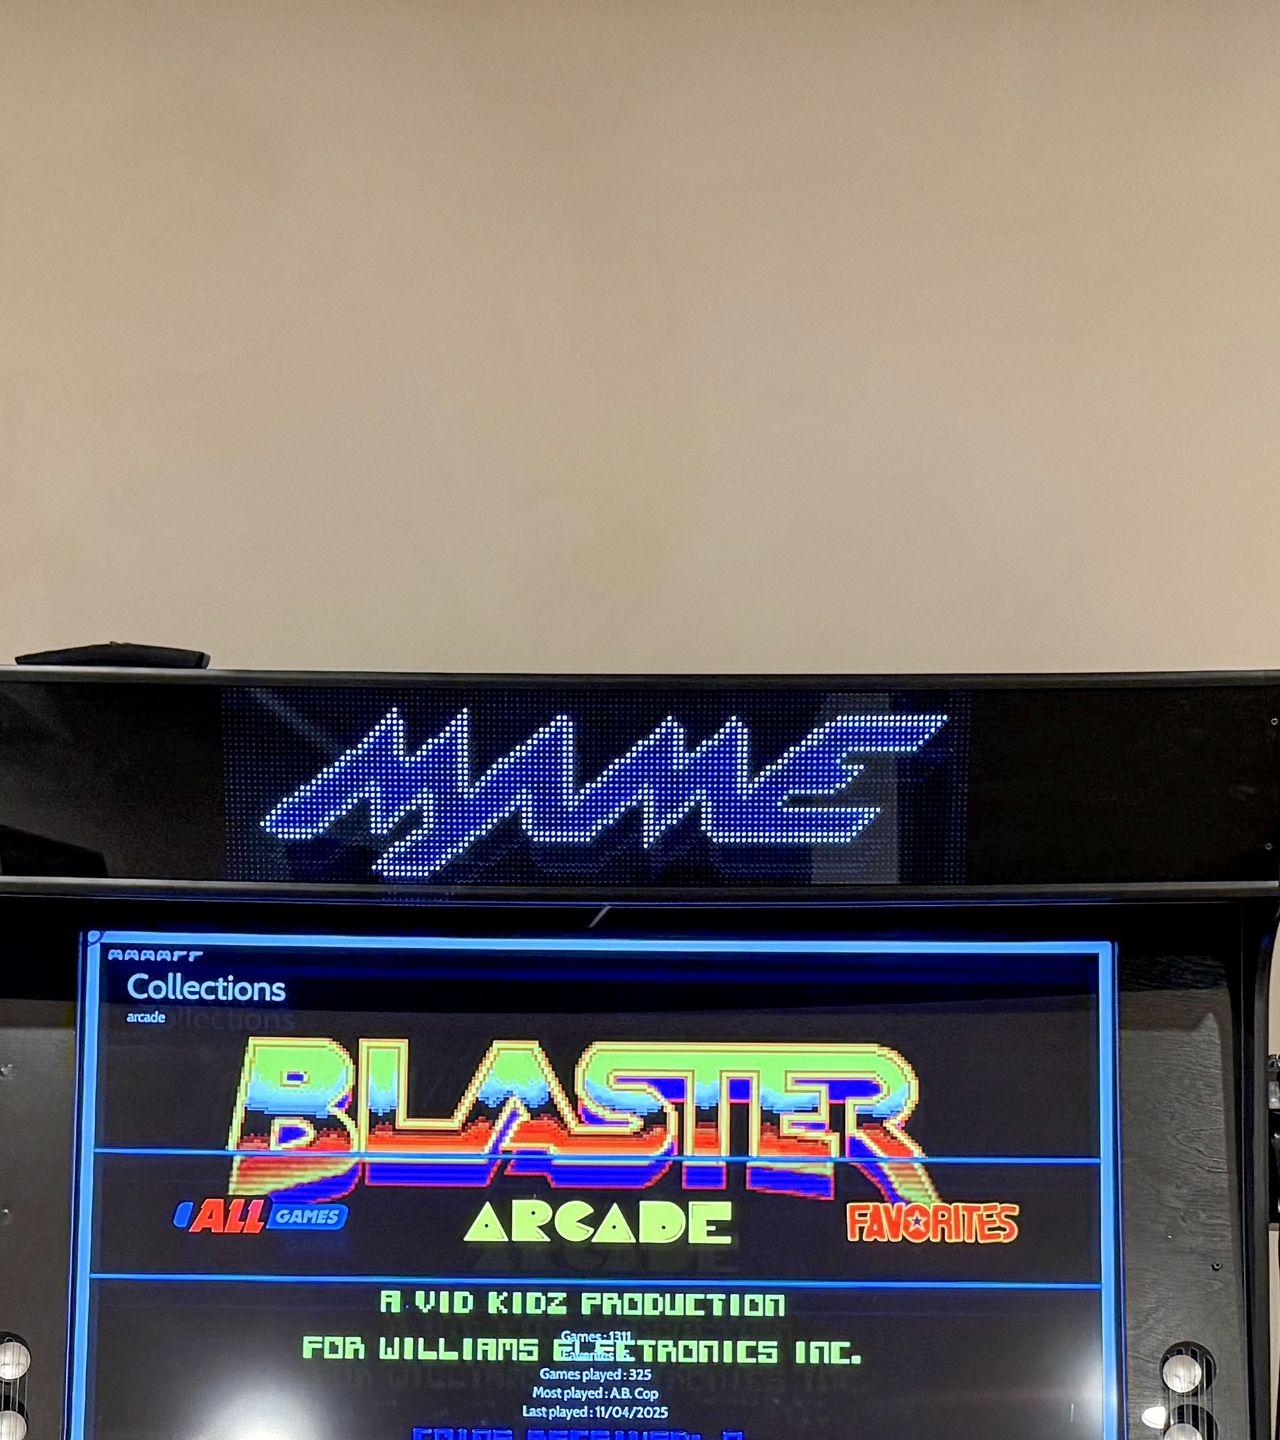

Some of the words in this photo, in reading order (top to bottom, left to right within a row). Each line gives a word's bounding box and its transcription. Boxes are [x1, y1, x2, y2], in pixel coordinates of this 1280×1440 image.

[126, 972, 287, 1002] Collections
[126, 1010, 166, 1024] arcade
[227, 1035, 942, 1204] BLASTER
[189, 1198, 265, 1234] ALL
[275, 1209, 340, 1225] GAMES
[463, 1198, 733, 1244] ARCADE
[846, 1202, 1020, 1244] FAVORITES
[380, 1290, 401, 1313] A
[415, 1290, 474, 1314] VID
[487, 1291, 568, 1315] KIDZ
[581, 1292, 786, 1317] PRODUCTION
[302, 1336, 366, 1360] FOR
[379, 1337, 539, 1362] WILLIAMS
[553, 1338, 780, 1364] ELECTRONICS
[795, 1341, 863, 1366] INC.
[560, 1330, 602, 1344] Games
[608, 1330, 632, 1344] 1311
[539, 1367, 581, 1381] Games
[582, 1367, 622, 1383] played
[628, 1368, 652, 1381] 325
[532, 1386, 562, 1399] Most
[564, 1386, 603, 1402] played
[610, 1387, 633, 1399] A.B.
[634, 1387, 659, 1402] Cop
[522, 1404, 547, 1418] Last
[548, 1405, 588, 1420] played
[595, 1406, 669, 1419] 11/04/2025
